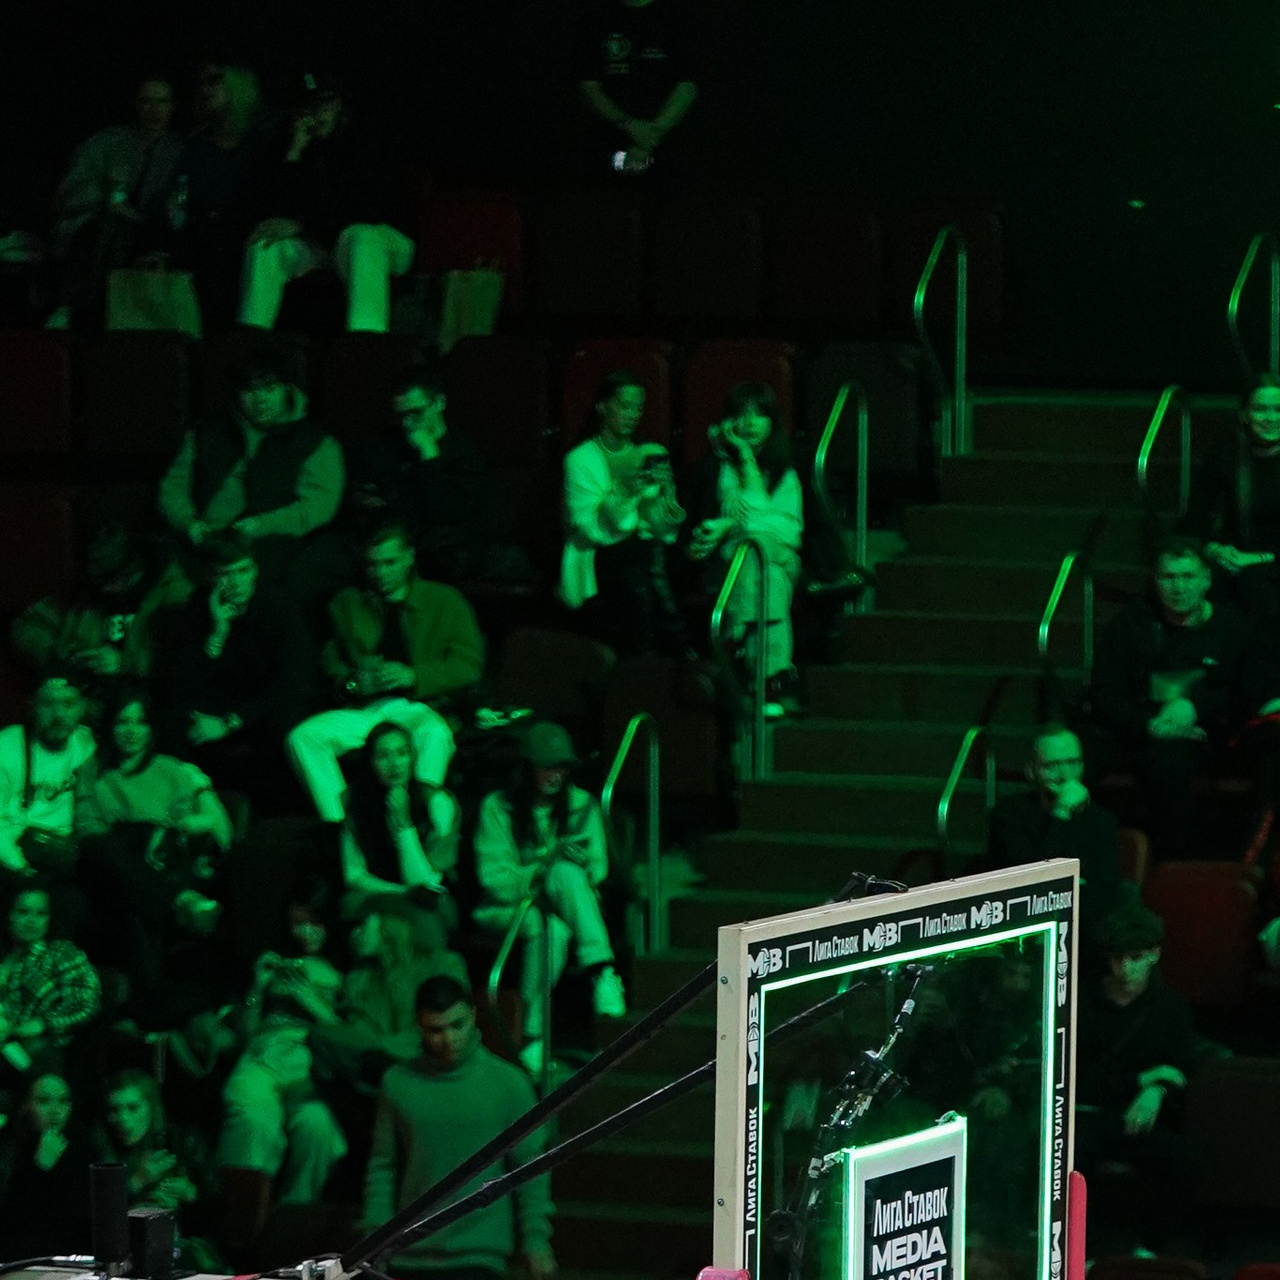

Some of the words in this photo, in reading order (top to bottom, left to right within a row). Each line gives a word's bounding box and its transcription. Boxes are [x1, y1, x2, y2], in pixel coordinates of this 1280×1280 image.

[873, 1199, 903, 1237] ЛИГА
[904, 1187, 948, 1227] СТАВОК
[872, 1226, 947, 1276] MEDIA
